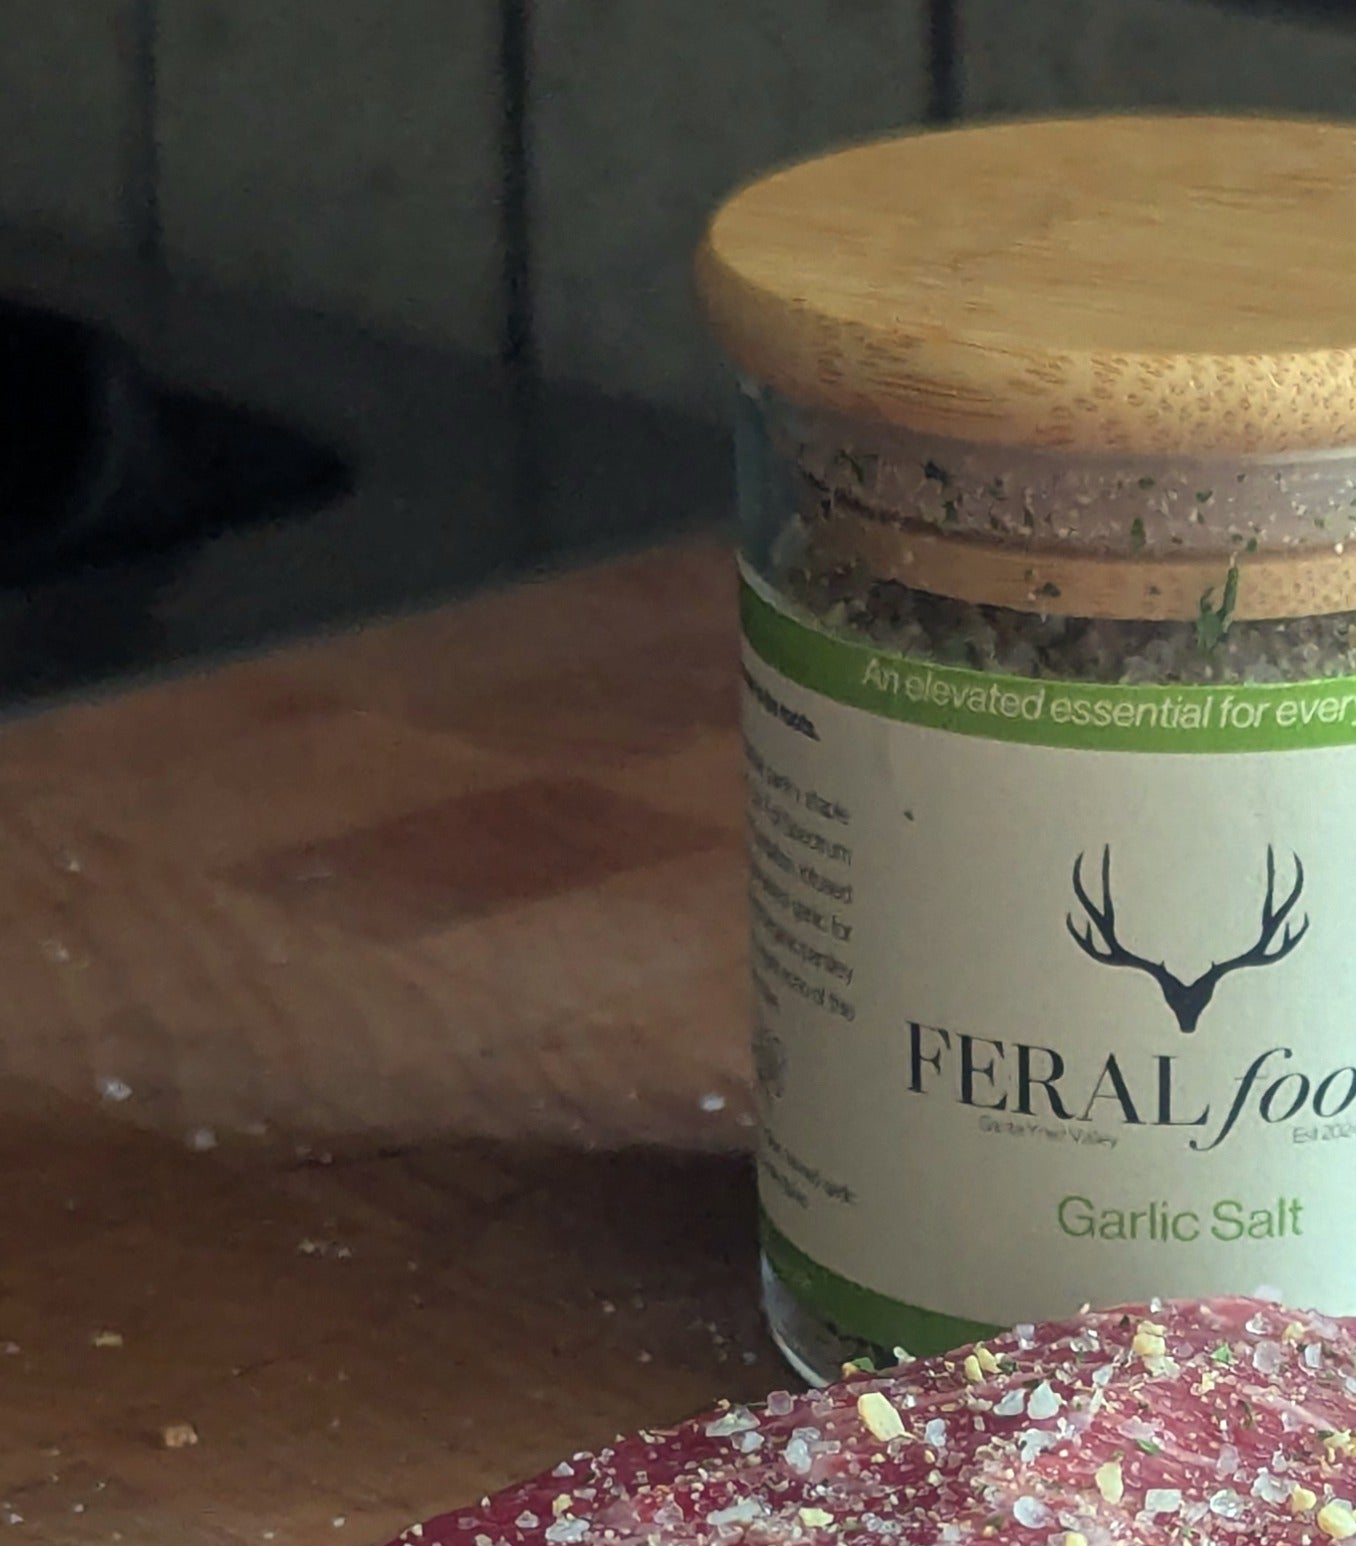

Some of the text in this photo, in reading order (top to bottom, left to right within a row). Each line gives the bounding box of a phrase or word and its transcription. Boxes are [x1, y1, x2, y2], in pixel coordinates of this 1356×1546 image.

[861, 657, 898, 694] An
[905, 670, 1045, 720] elevated
[1050, 694, 1213, 730] essential
[1218, 694, 1270, 729] for
[905, 1019, 1211, 1127] FERAL
[1057, 1194, 1305, 1243] Garlic Salt
